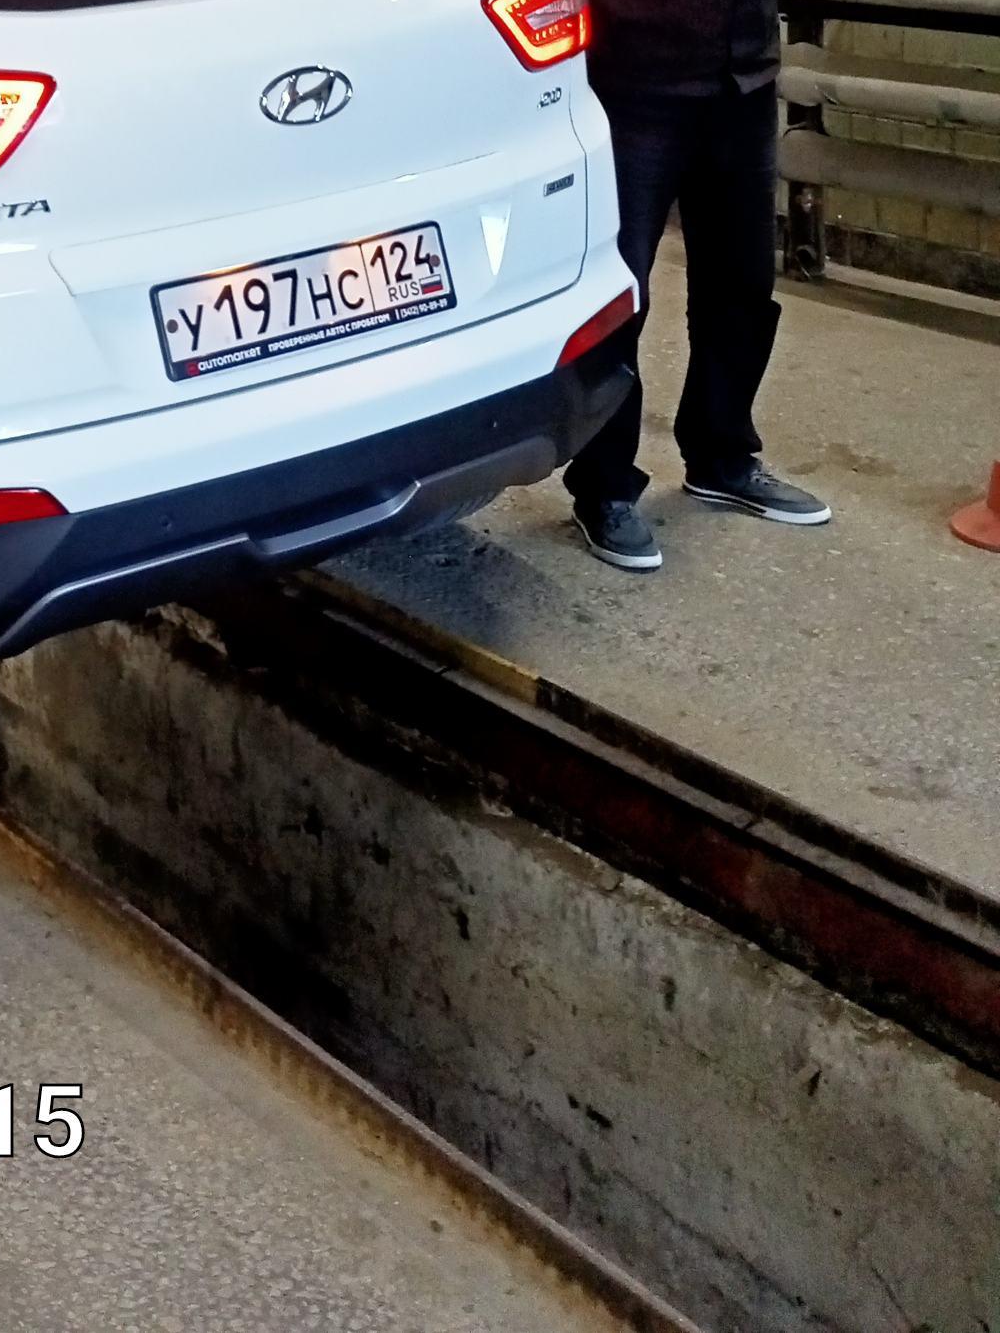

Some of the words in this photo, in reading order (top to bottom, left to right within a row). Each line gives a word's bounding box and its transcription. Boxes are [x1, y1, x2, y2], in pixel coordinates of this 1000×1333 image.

[369, 234, 436, 286] 124
[387, 281, 420, 303] RUS
[268, 330, 325, 352] ПРОВЕРЕННЫЕ
[325, 324, 346, 339] АВТО
[351, 313, 391, 331] ПРОБЕГОМ
